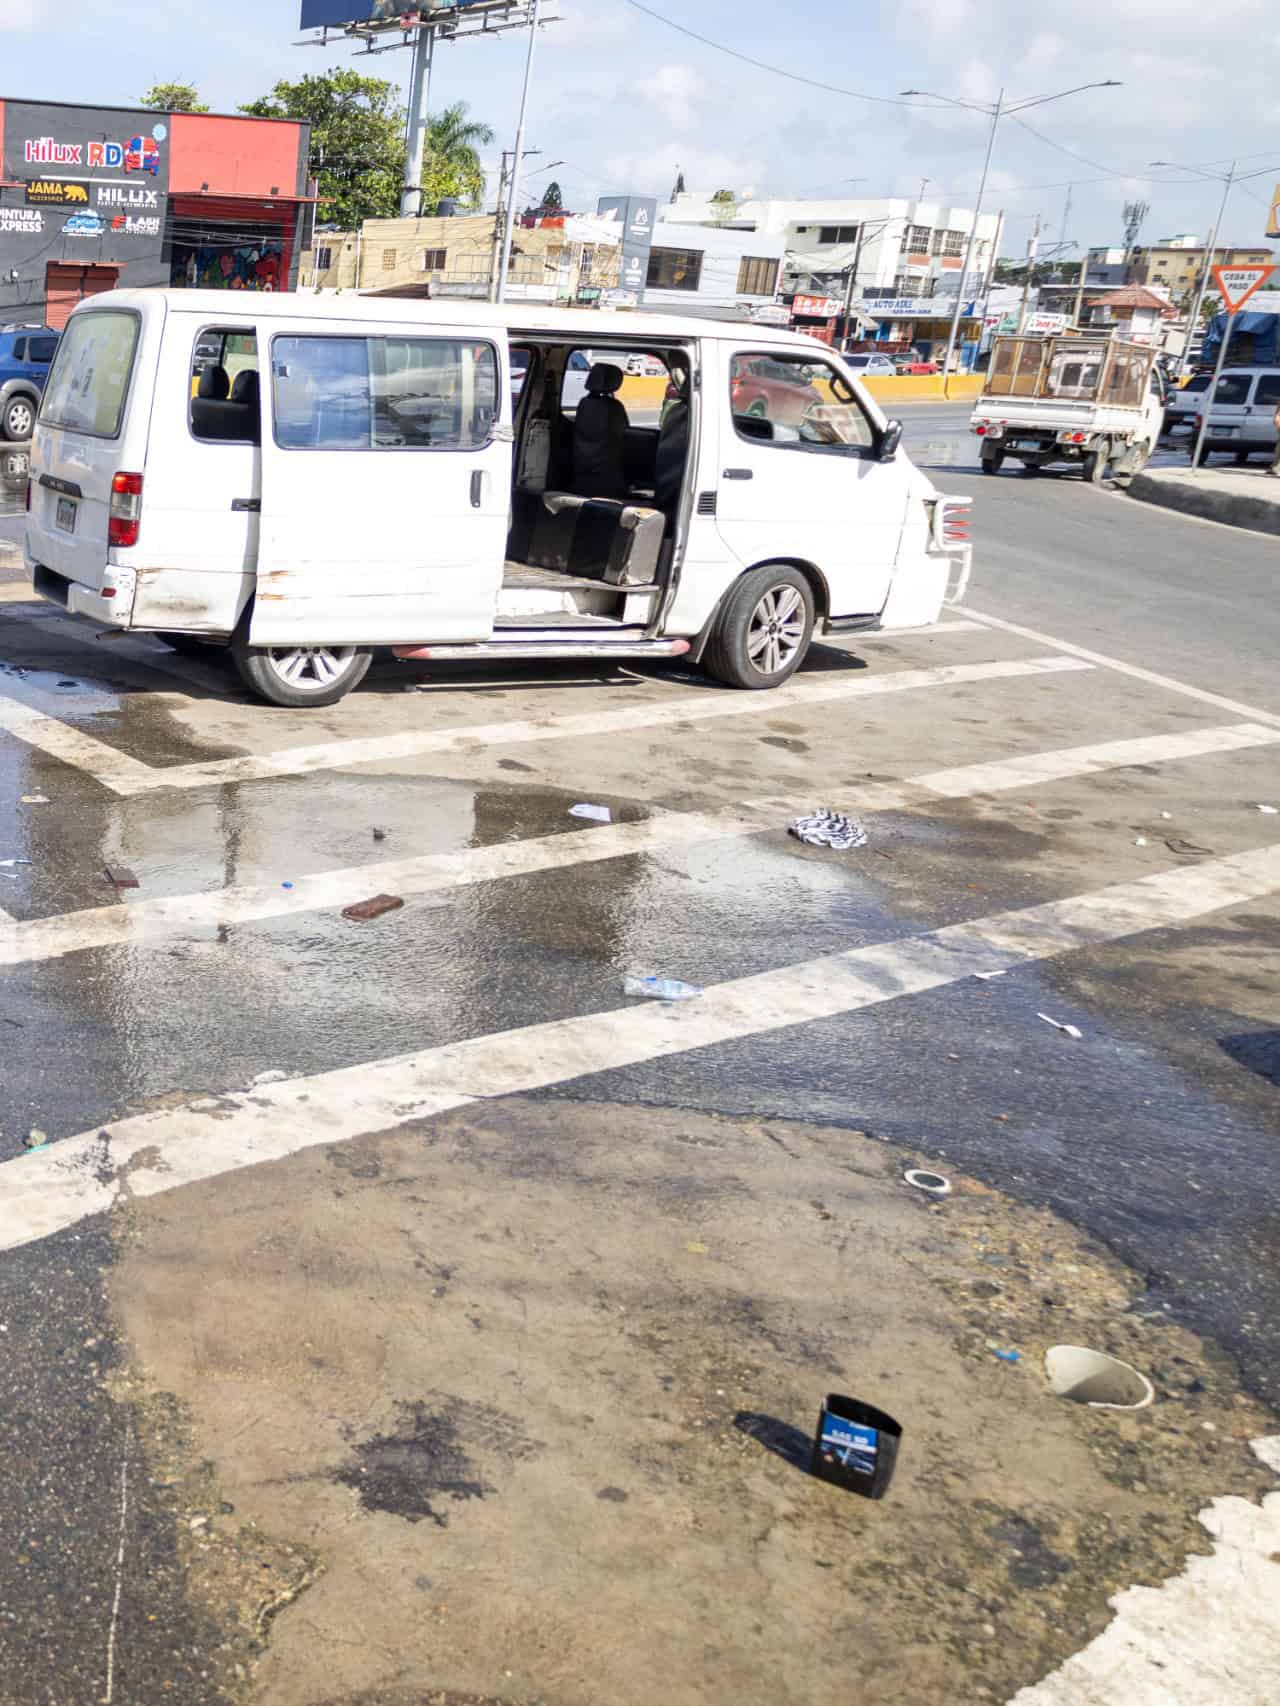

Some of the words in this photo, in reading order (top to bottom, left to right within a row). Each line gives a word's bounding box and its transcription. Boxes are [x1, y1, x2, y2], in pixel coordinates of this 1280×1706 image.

[25, 136, 81, 164] Hilux
[87, 142, 123, 167] RD
[28, 181, 63, 194] JAMA
[1224, 272, 1246, 281] CEDA
[1247, 272, 1257, 281] EL
[1228, 282, 1249, 290] PASO
[873, 301, 895, 309] AUTO
